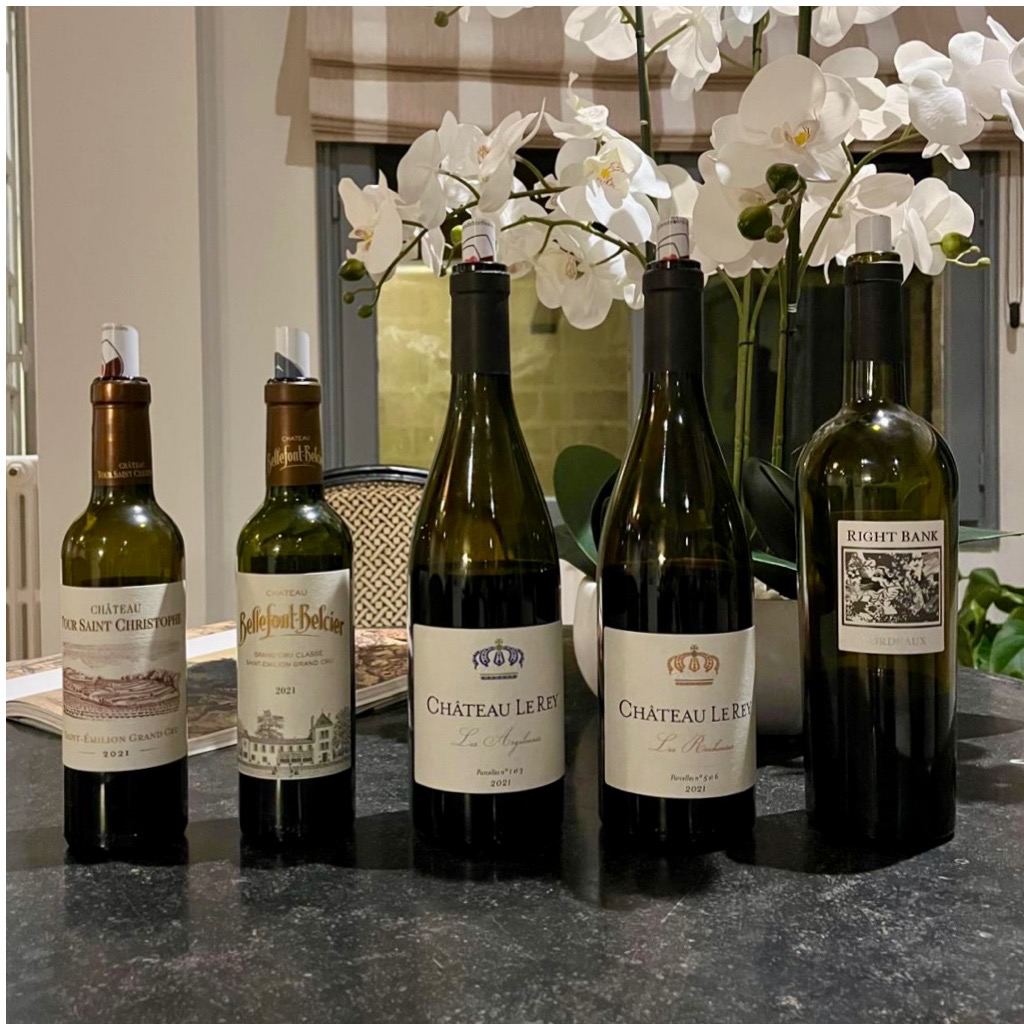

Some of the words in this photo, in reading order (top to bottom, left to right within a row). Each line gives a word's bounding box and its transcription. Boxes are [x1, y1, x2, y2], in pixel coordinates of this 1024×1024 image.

[847, 530, 897, 542] RIGHT
[901, 530, 939, 543] BANK
[90, 603, 142, 615] CHÂTEAU
[79, 618, 113, 632] SAINT
[238, 602, 345, 648] Bellefont-Belcier
[275, 686, 296, 695] 2021
[426, 695, 511, 718] CHÂTEAU
[516, 698, 535, 716] LE
[537, 693, 559, 713] REY
[619, 699, 706, 724] CHÂTEAU
[711, 705, 730, 723] LE
[128, 731, 163, 743] GRAND
[102, 750, 130, 758] 2021
[490, 779, 511, 788] 2021
[685, 785, 706, 793] 2021
